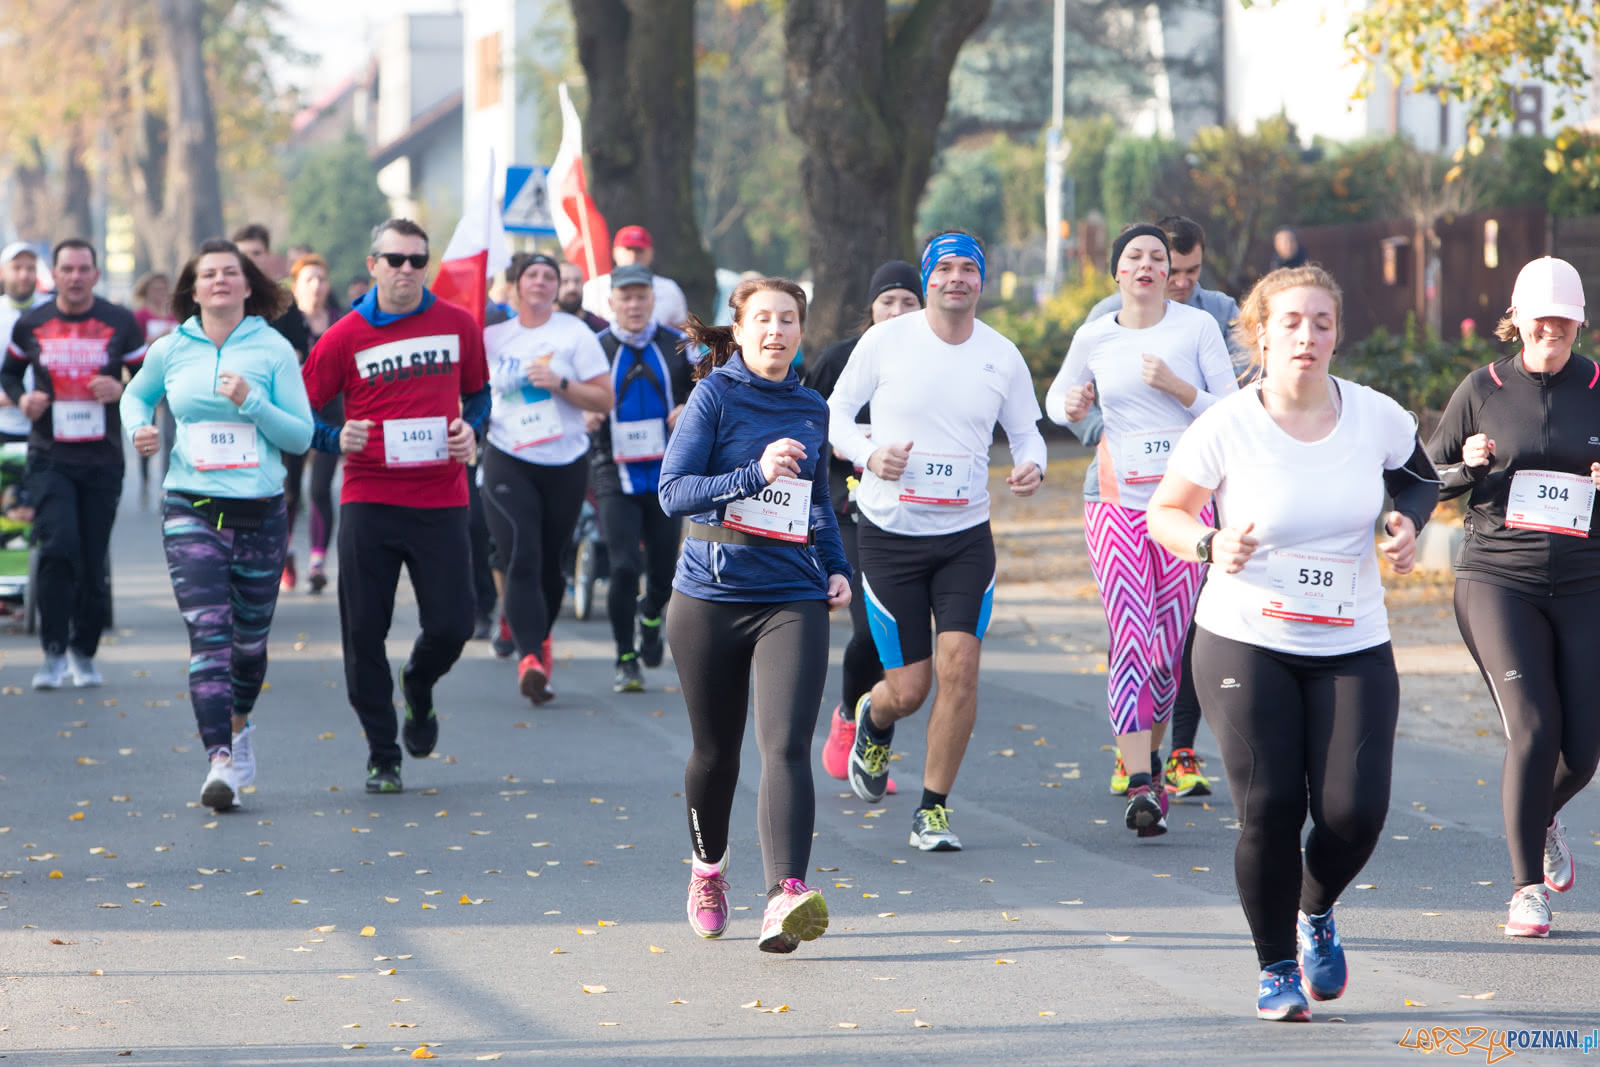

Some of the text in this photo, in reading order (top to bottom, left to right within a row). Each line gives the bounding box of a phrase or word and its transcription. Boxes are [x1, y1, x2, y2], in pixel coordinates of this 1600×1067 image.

[366, 349, 453, 386] POLSKA
[211, 432, 235, 445] 883
[402, 429, 433, 442] 1401
[1144, 440, 1171, 454] 379
[925, 463, 953, 477] 378
[1537, 484, 1569, 501] 304
[1298, 568, 1334, 587] 538
